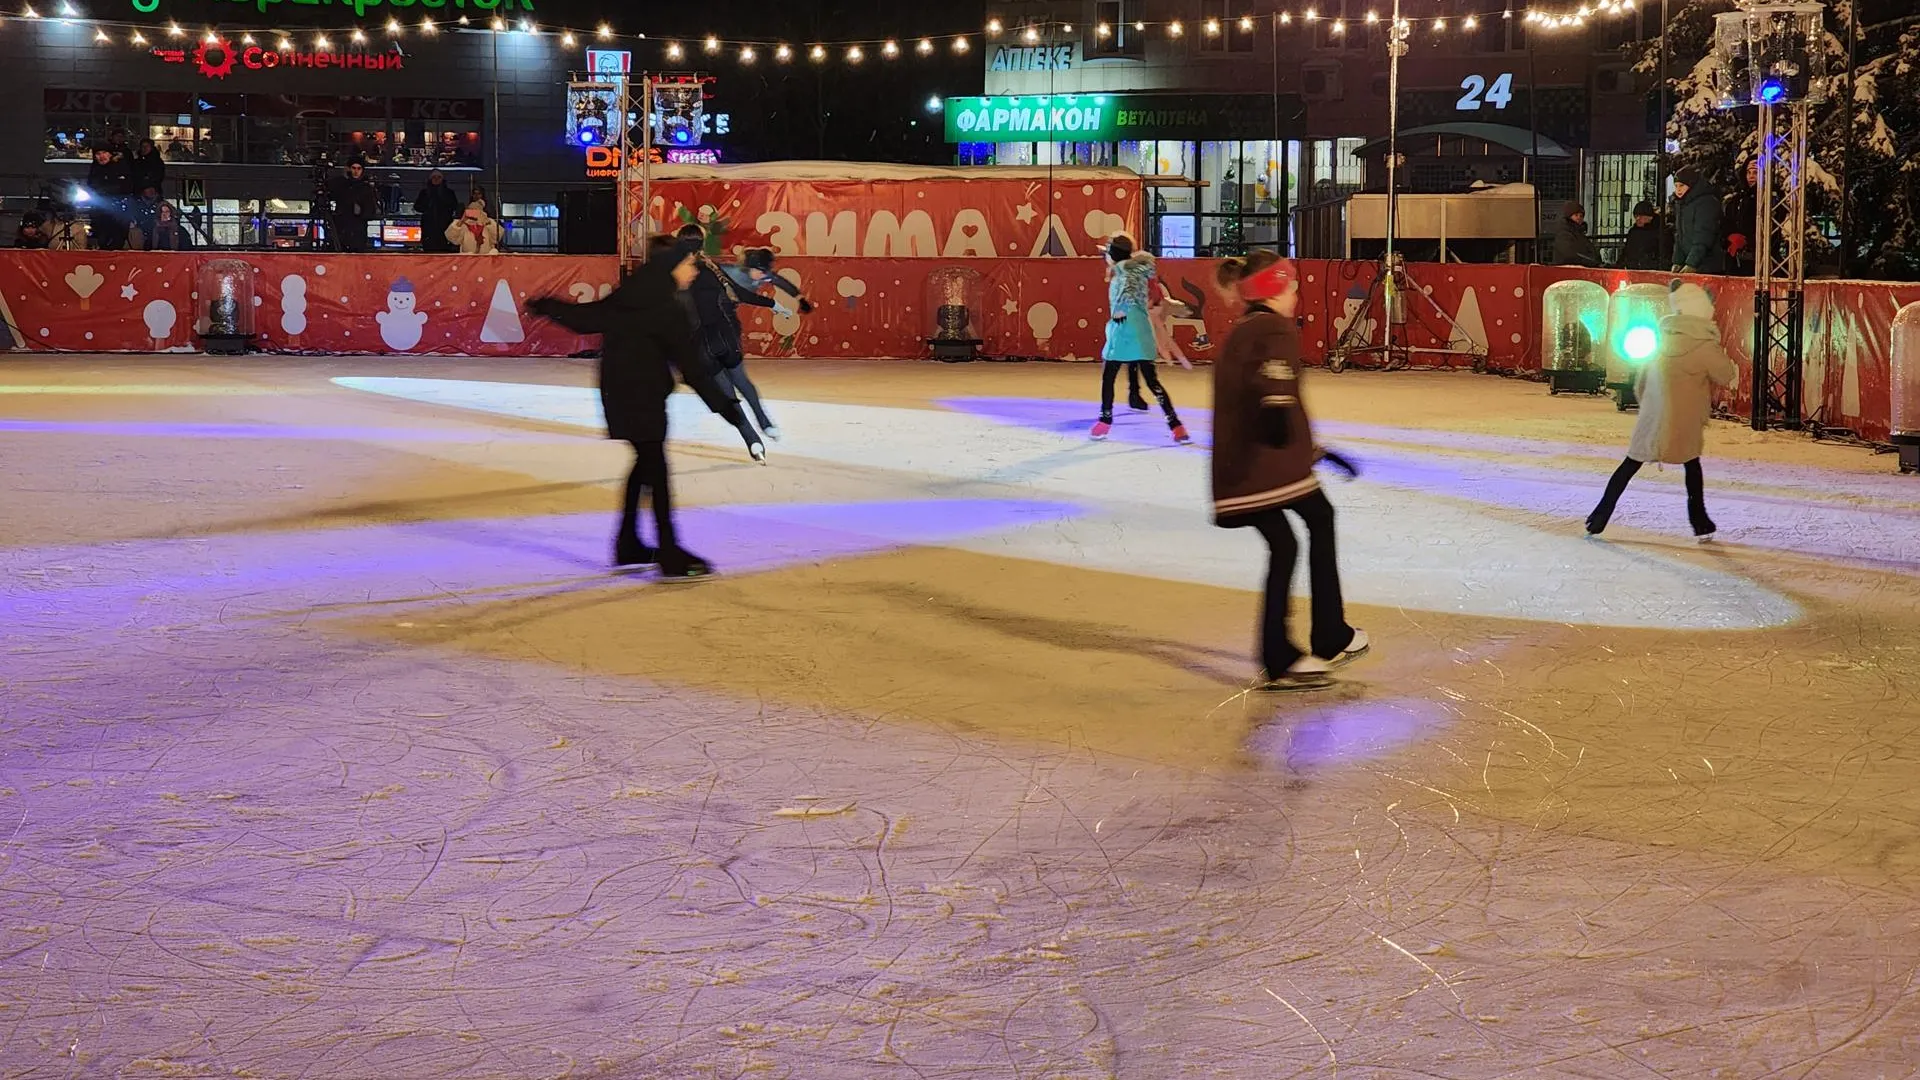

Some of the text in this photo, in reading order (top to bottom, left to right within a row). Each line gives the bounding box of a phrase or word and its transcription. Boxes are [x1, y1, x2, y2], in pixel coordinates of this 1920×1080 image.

[243, 47, 403, 70] Солнечный
[991, 45, 1073, 71] АПТЕКЕ
[62, 91, 123, 111] KFC
[1456, 73, 1513, 110] 24
[411, 99, 467, 118] KFC
[957, 106, 1100, 132] ФАРМАКОН
[1116, 110, 1208, 127] ВЕТАПТЕКА
[755, 208, 998, 257] ЗИМА
